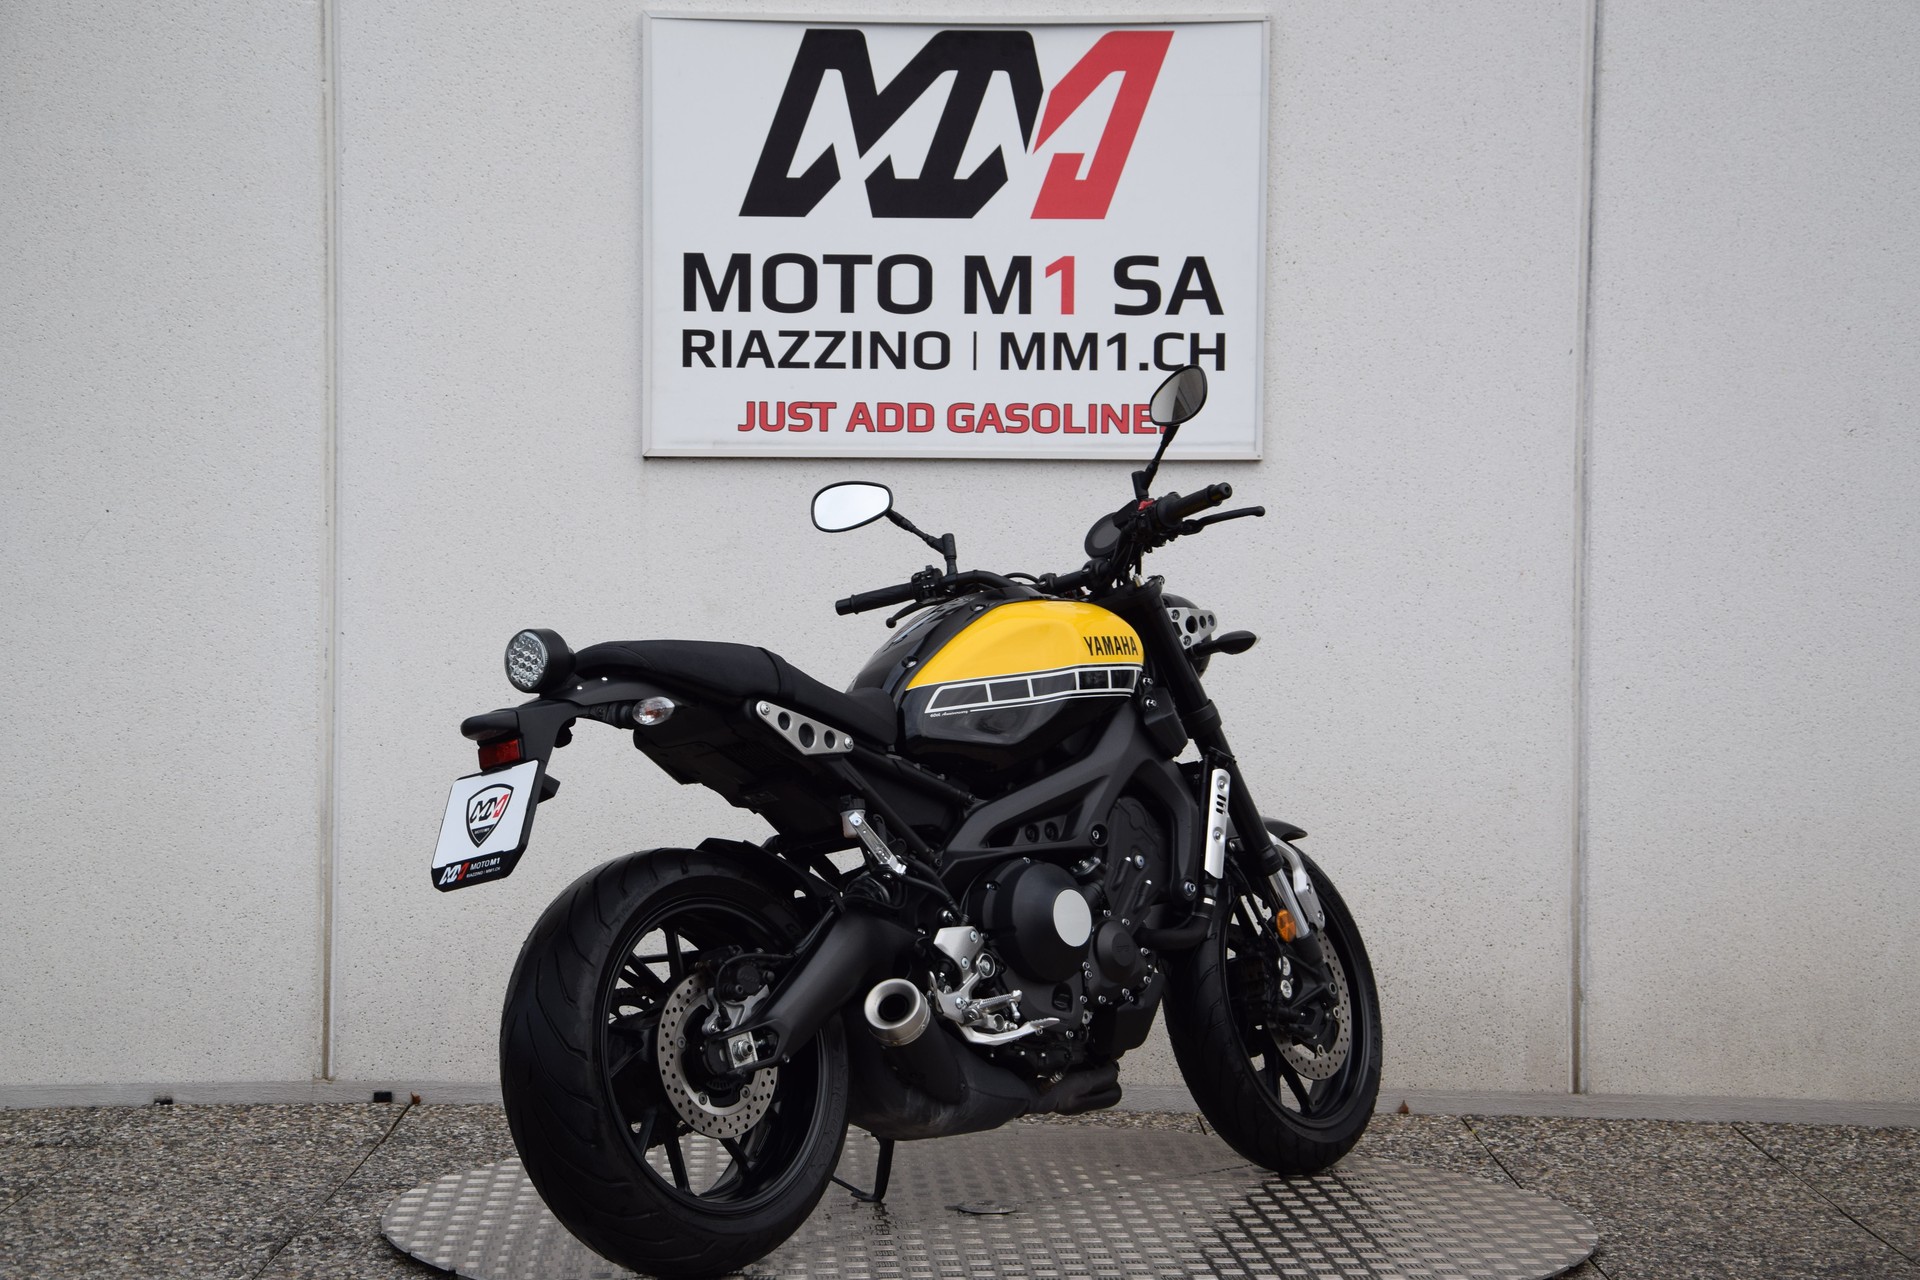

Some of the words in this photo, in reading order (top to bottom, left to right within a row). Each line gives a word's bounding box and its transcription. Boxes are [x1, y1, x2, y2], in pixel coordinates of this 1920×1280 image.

[683, 252, 933, 315] MOTO
[963, 255, 1076, 316] M1
[1113, 254, 1225, 317] SA
[682, 328, 951, 371] RIAZZINO
[1000, 331, 1226, 373] MM1.CH
[737, 400, 838, 433] JUST
[845, 401, 935, 433] ADD
[946, 402, 1167, 435] GASOLINE
[1083, 636, 1139, 656] YAMAHA
